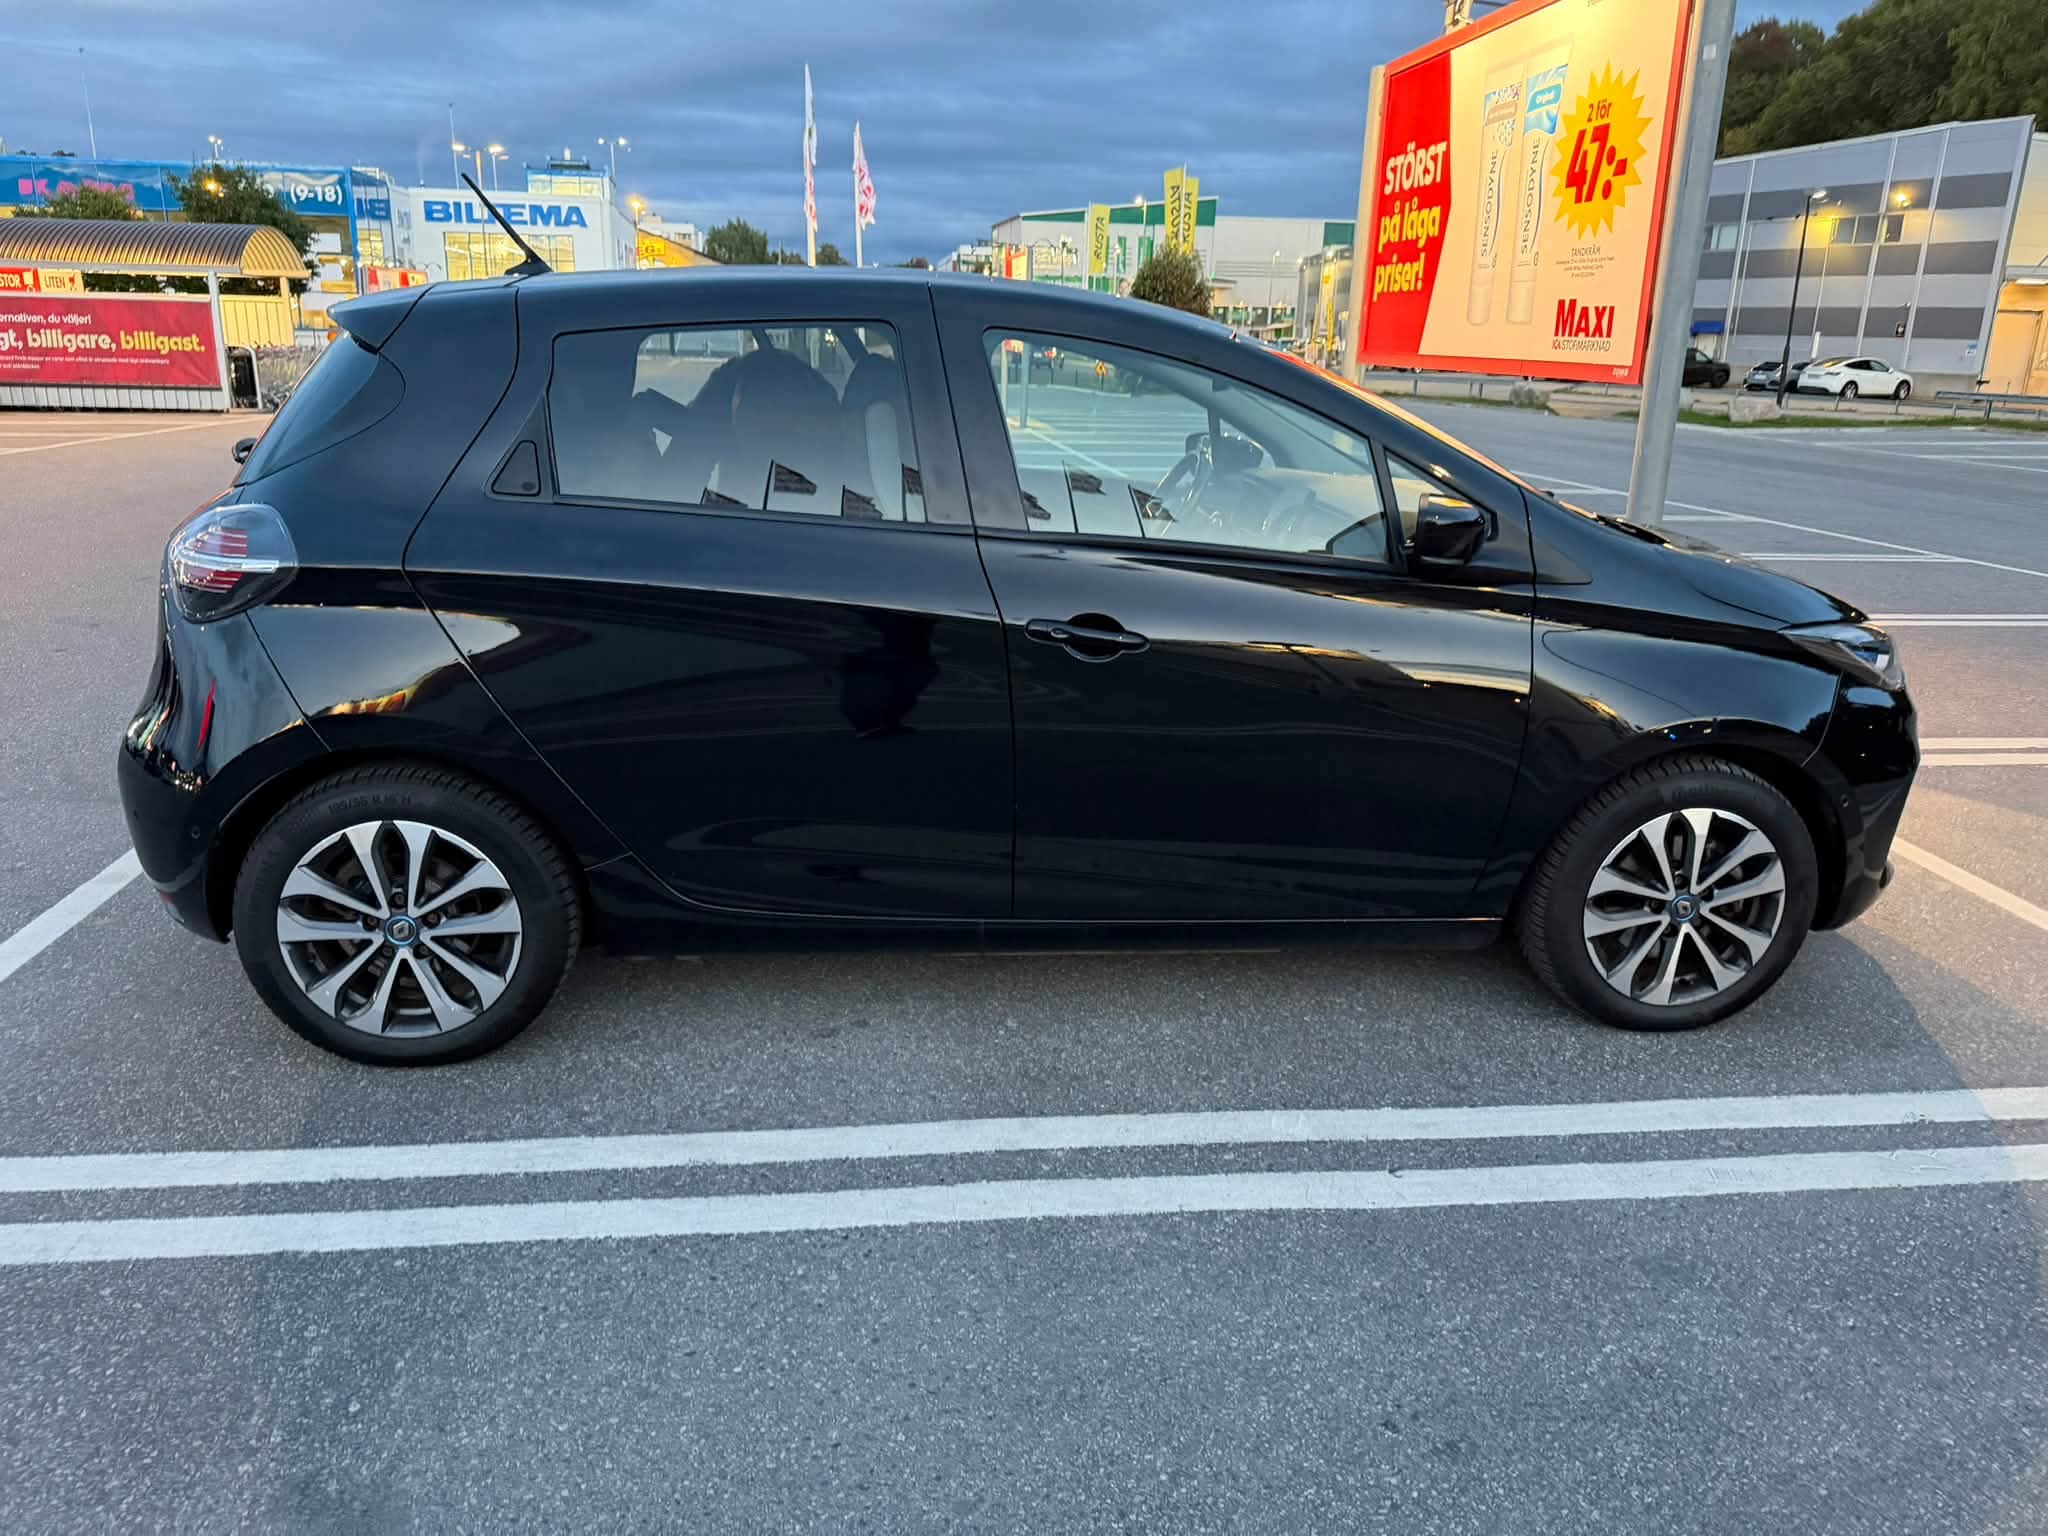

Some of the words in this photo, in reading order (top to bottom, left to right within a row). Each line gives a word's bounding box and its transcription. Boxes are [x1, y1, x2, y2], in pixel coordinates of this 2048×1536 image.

[1587, 103, 1595, 122] 2
[1595, 98, 1612, 120] för
[1384, 141, 1447, 195] STÖRST
[1565, 123, 1628, 204] 47:-
[291, 183, 342, 206] (9-18)
[1480, 151, 1499, 257] SENSODYNE
[1521, 138, 1541, 255] SENSODYNE
[1093, 216, 1105, 260] RUSTA
[1378, 200, 1401, 254] på
[1402, 196, 1441, 249] låga
[44, 274, 66, 289] LITEN
[1373, 252, 1425, 302] priser!
[26, 328, 117, 353] billigare,
[120, 330, 206, 355] billigast.
[47, 313, 61, 324] du
